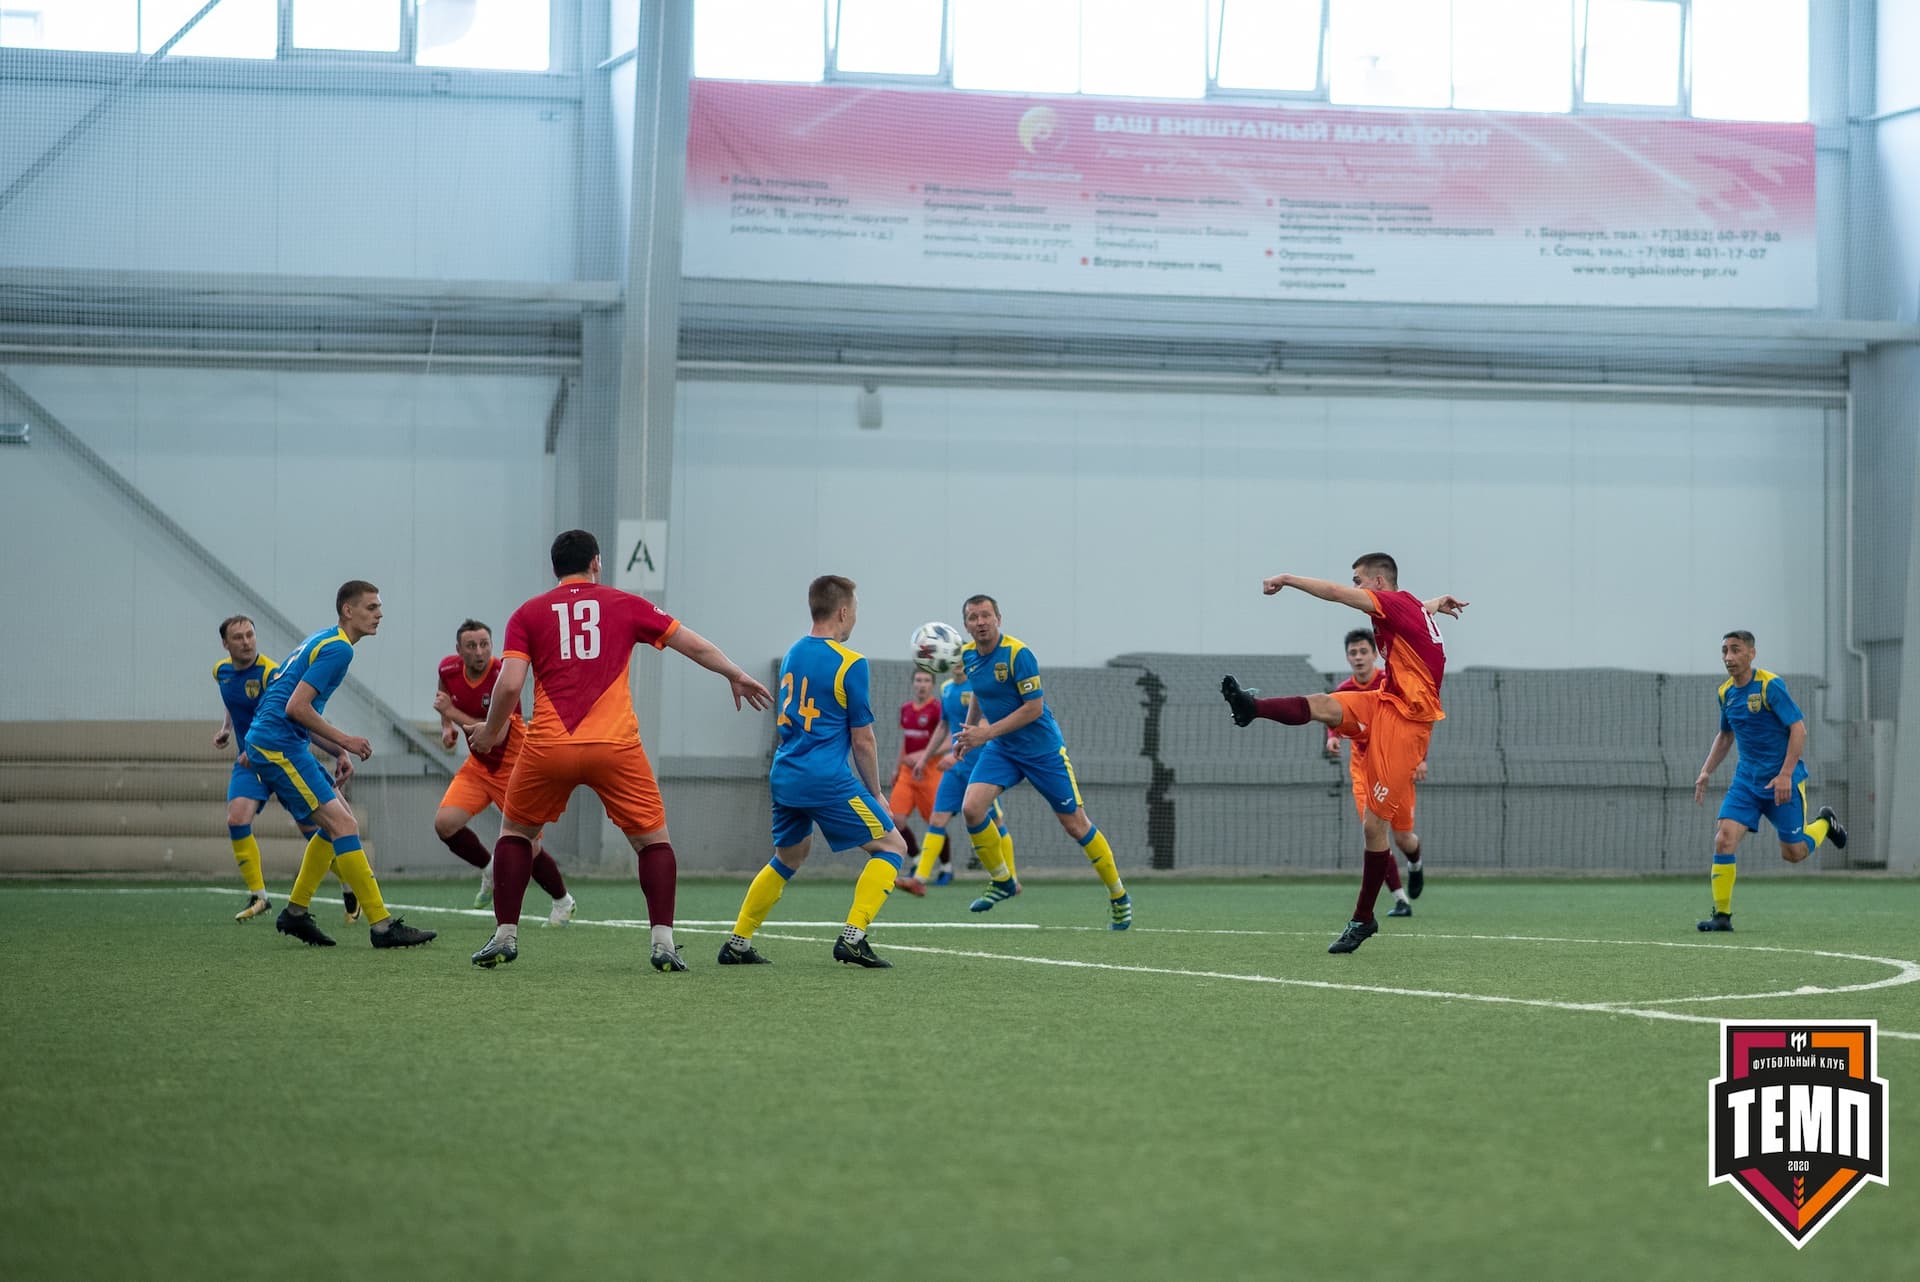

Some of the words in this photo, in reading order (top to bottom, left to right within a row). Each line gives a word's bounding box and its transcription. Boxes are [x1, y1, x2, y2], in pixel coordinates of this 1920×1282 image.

[1094, 115, 1151, 134] ВАШ
[1157, 116, 1328, 142] ВНЕШТАТНЫЙ
[1333, 123, 1489, 146] МАРКЕТОЛОГ
[551, 599, 602, 661] 13
[776, 672, 822, 733] 24
[1373, 781, 1390, 803] 42
